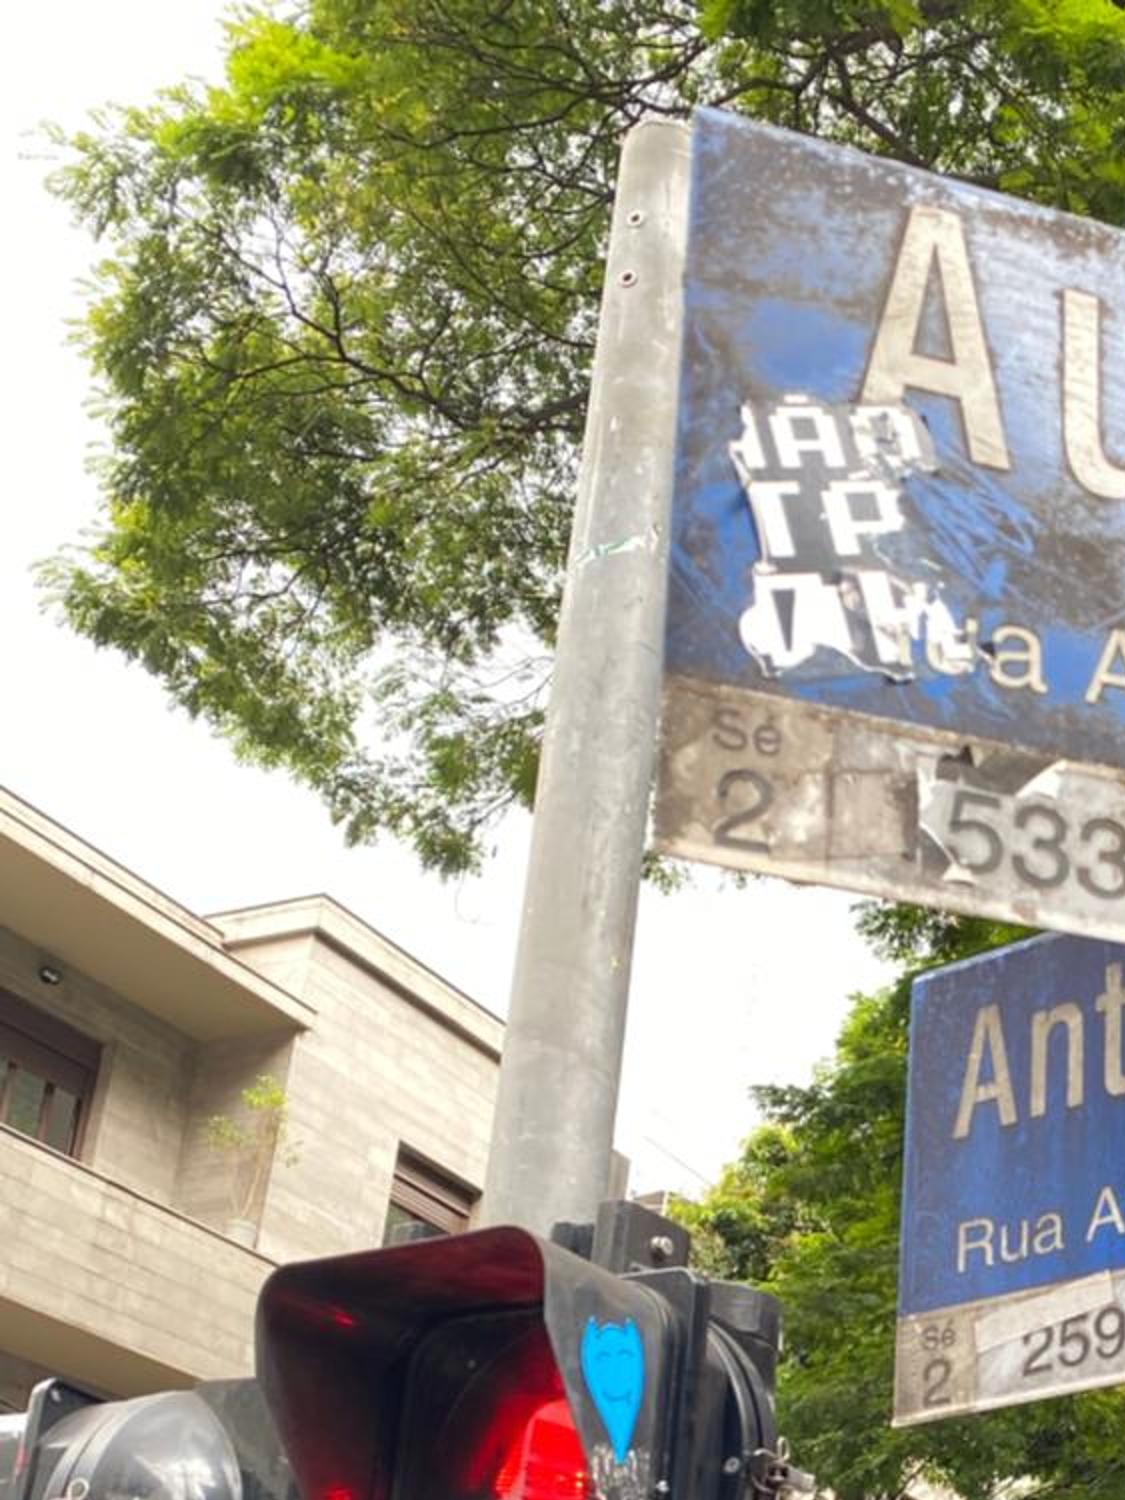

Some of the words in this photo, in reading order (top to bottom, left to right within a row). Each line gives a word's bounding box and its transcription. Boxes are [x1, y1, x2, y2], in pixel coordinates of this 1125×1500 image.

[898, 614, 1049, 694] ua
[711, 708, 783, 753] Sé
[714, 768, 776, 852] 2
[956, 1210, 1065, 1273] Rua
[922, 1324, 956, 1350] Sé
[921, 1358, 953, 1405] 2
